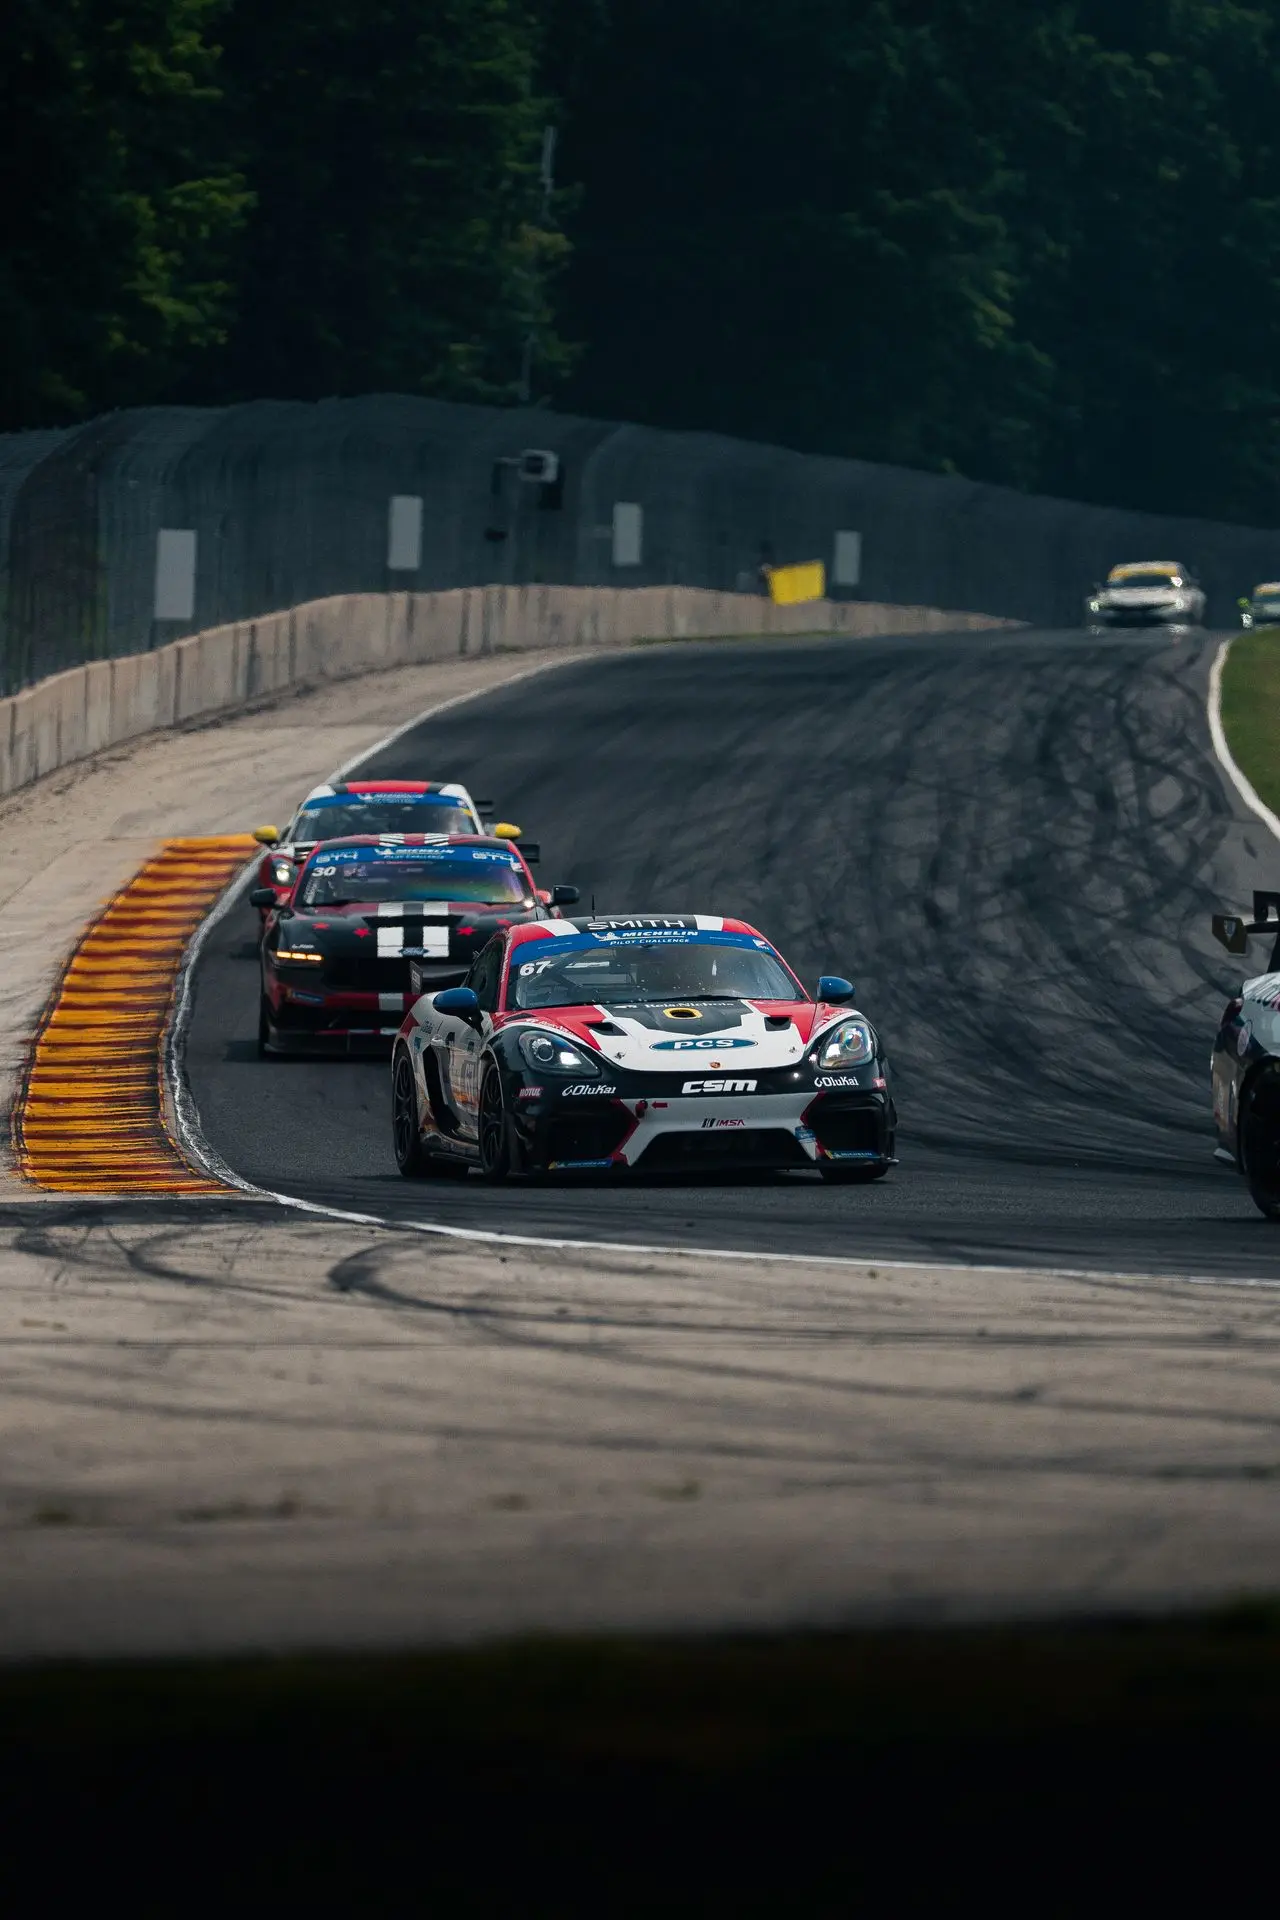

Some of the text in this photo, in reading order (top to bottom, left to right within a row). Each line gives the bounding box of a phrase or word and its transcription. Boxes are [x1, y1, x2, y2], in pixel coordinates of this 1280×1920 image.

[311, 866, 336, 877] 30
[587, 919, 686, 931] SMITH
[622, 929, 699, 938] MICHELIN
[638, 937, 690, 945] CHALLENGE
[519, 961, 551, 977] 67
[673, 1039, 735, 1050] PCS
[824, 1076, 860, 1088] OluKai
[572, 1084, 617, 1097] OluKai
[715, 1118, 746, 1128] IMSA
